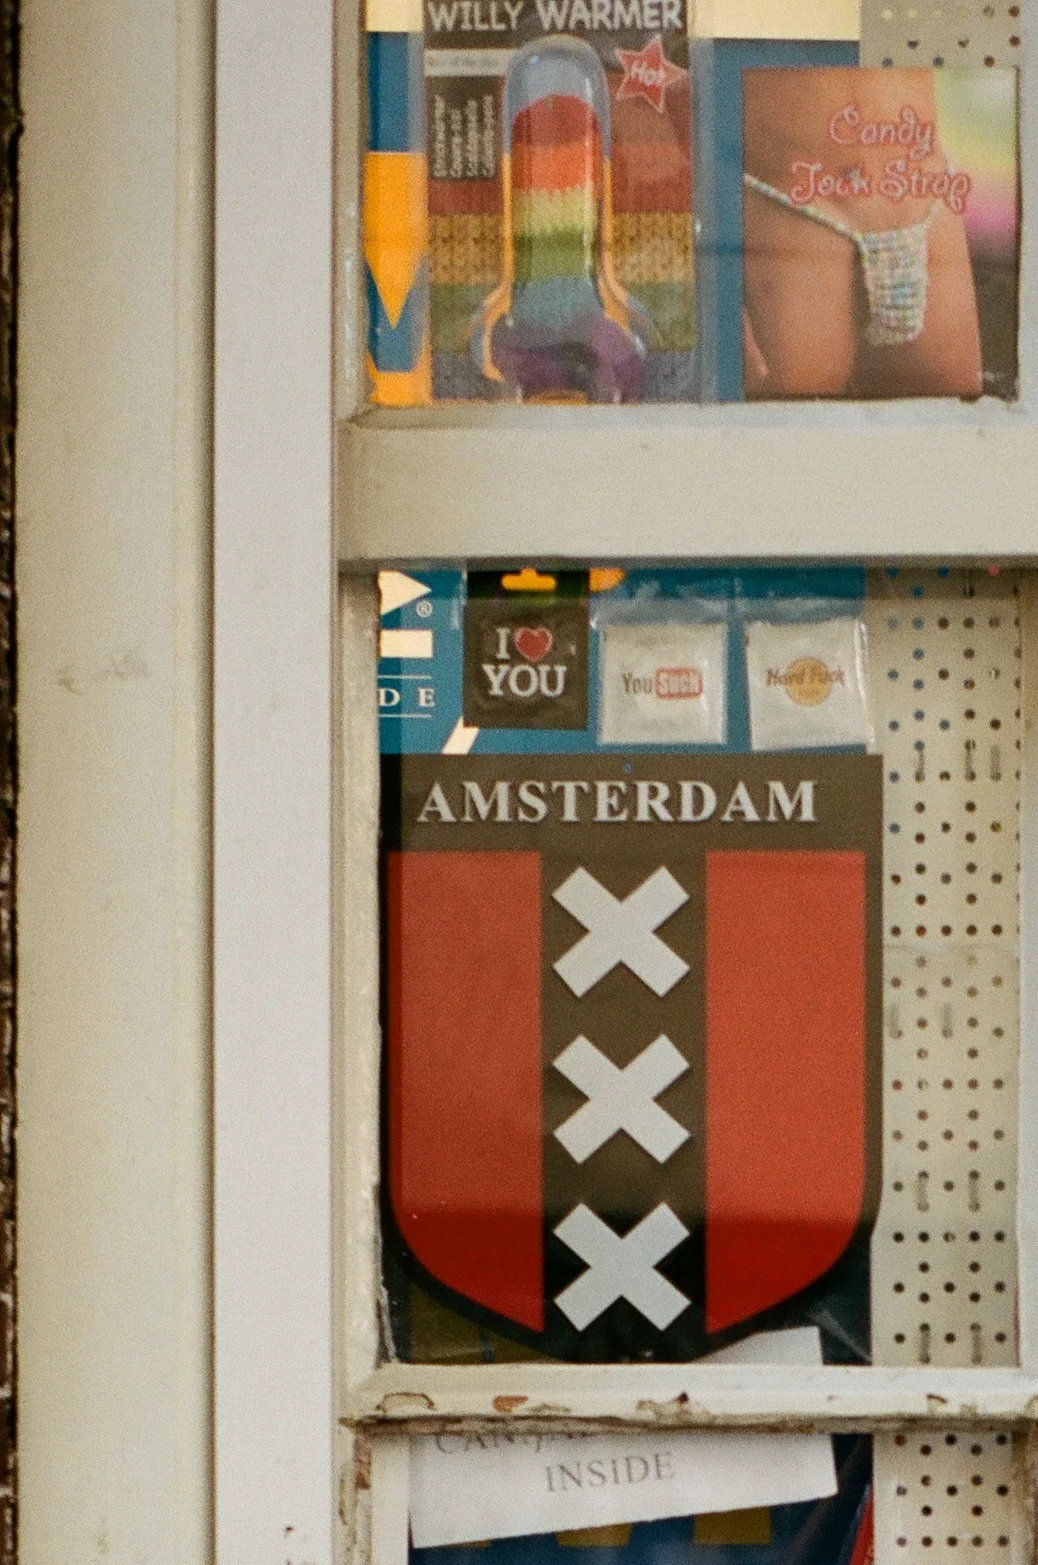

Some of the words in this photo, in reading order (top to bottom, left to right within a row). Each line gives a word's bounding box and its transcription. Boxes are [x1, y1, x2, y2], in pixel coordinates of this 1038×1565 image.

[427, 0, 523, 31] WILLY
[535, 0, 683, 31] WARMER
[830, 104, 935, 162] Candy
[879, 157, 971, 214] Strap
[496, 627, 511, 659] I
[482, 664, 567, 698] YOU
[622, 672, 652, 696] You
[416, 779, 820, 824] AMSTERDAM
[544, 1451, 675, 1492] INSIDE
